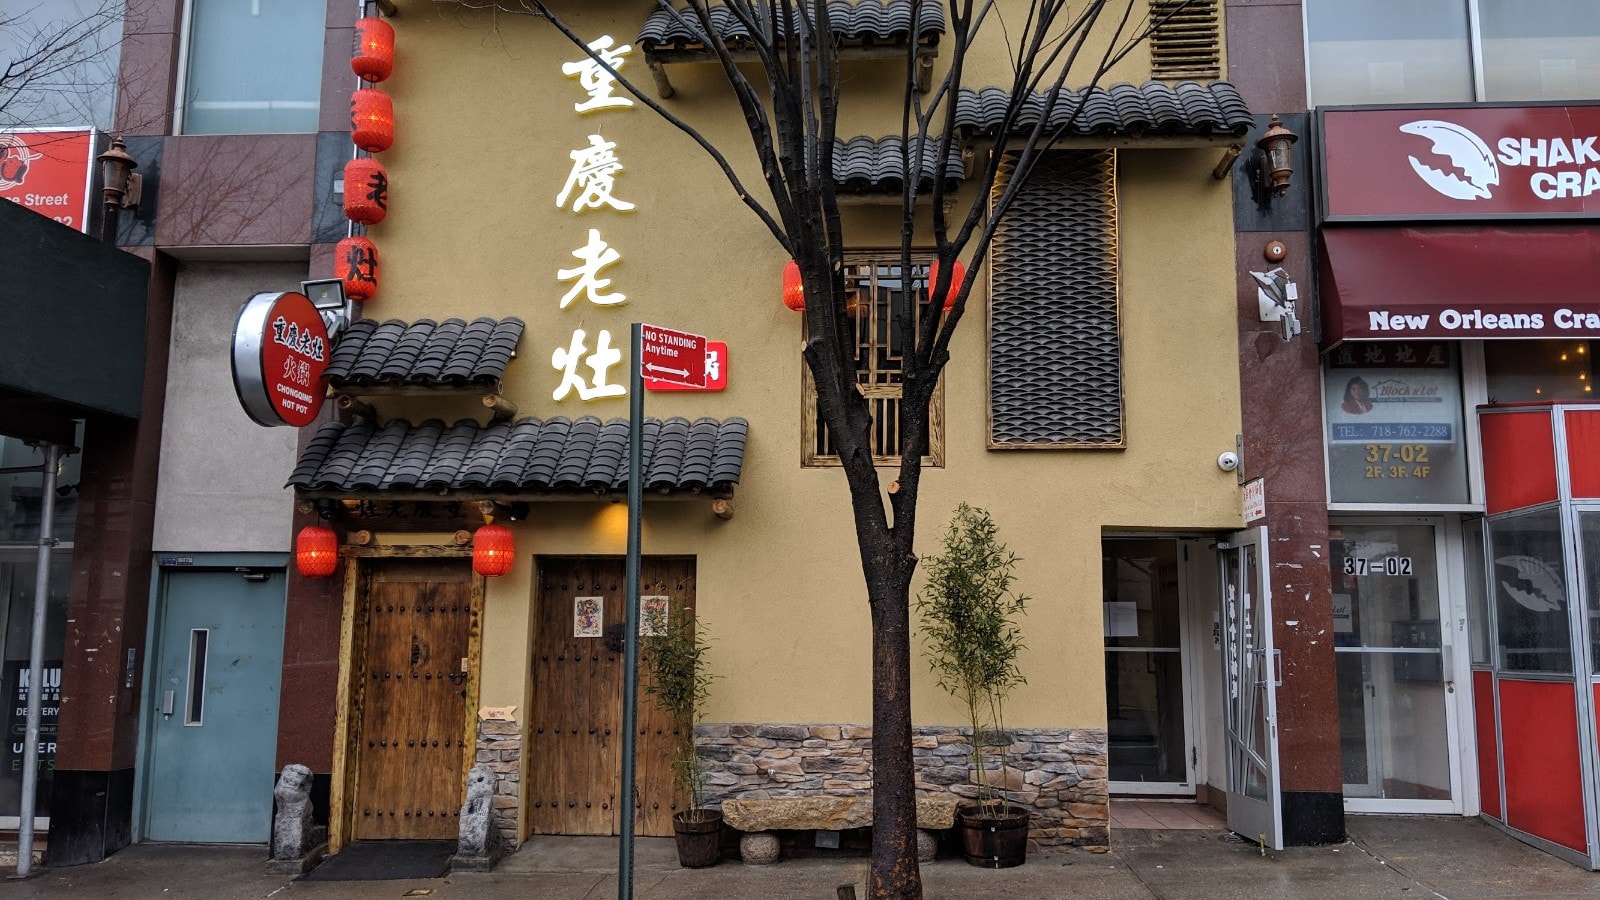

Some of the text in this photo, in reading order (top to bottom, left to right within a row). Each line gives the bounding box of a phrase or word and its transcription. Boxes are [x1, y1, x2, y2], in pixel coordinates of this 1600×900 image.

[24, 193, 69, 206] Street
[552, 34, 635, 401] 重慶老灶
[1368, 310, 1429, 331] New
[1439, 309, 1544, 330] Orleans
[273, 316, 324, 362] 重慶老灶
[645, 331, 696, 349] NO STANDING
[645, 343, 678, 357] Anytime
[277, 383, 313, 403] CHONGQING
[1380, 385, 1410, 396] Block
[1420, 385, 1438, 396] Lot
[282, 398, 308, 414] HOT POT
[1338, 425, 1448, 437] TEL: 718-762-2288
[1364, 444, 1429, 463] 37-02
[1413, 465, 1431, 478] 4F
[1344, 557, 1412, 576] 37-02
[19, 668, 62, 688] KLU
[16, 707, 60, 716] DEERY
[12, 742, 57, 753] UER
[11, 759, 55, 771] ETS
